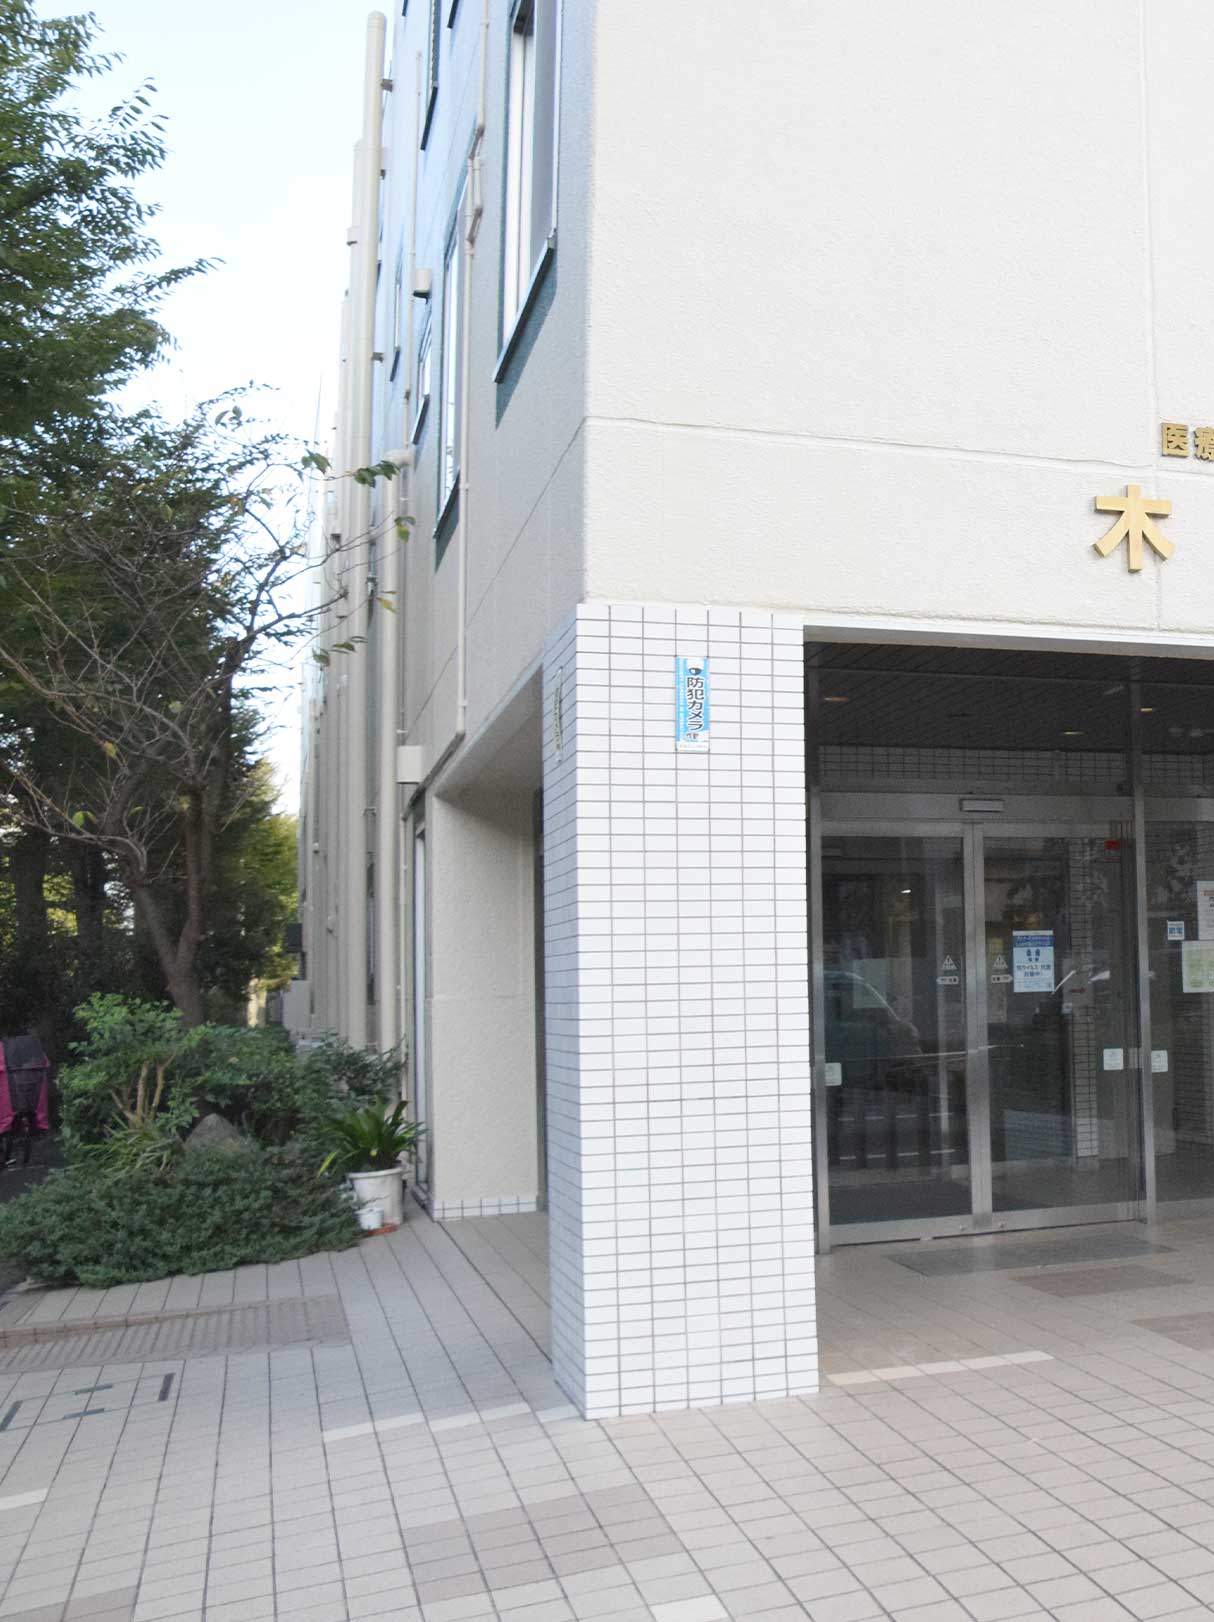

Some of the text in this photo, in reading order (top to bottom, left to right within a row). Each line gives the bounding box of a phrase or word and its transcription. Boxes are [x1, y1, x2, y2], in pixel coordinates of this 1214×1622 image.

[686, 676, 704, 731] 防犯カメラ
